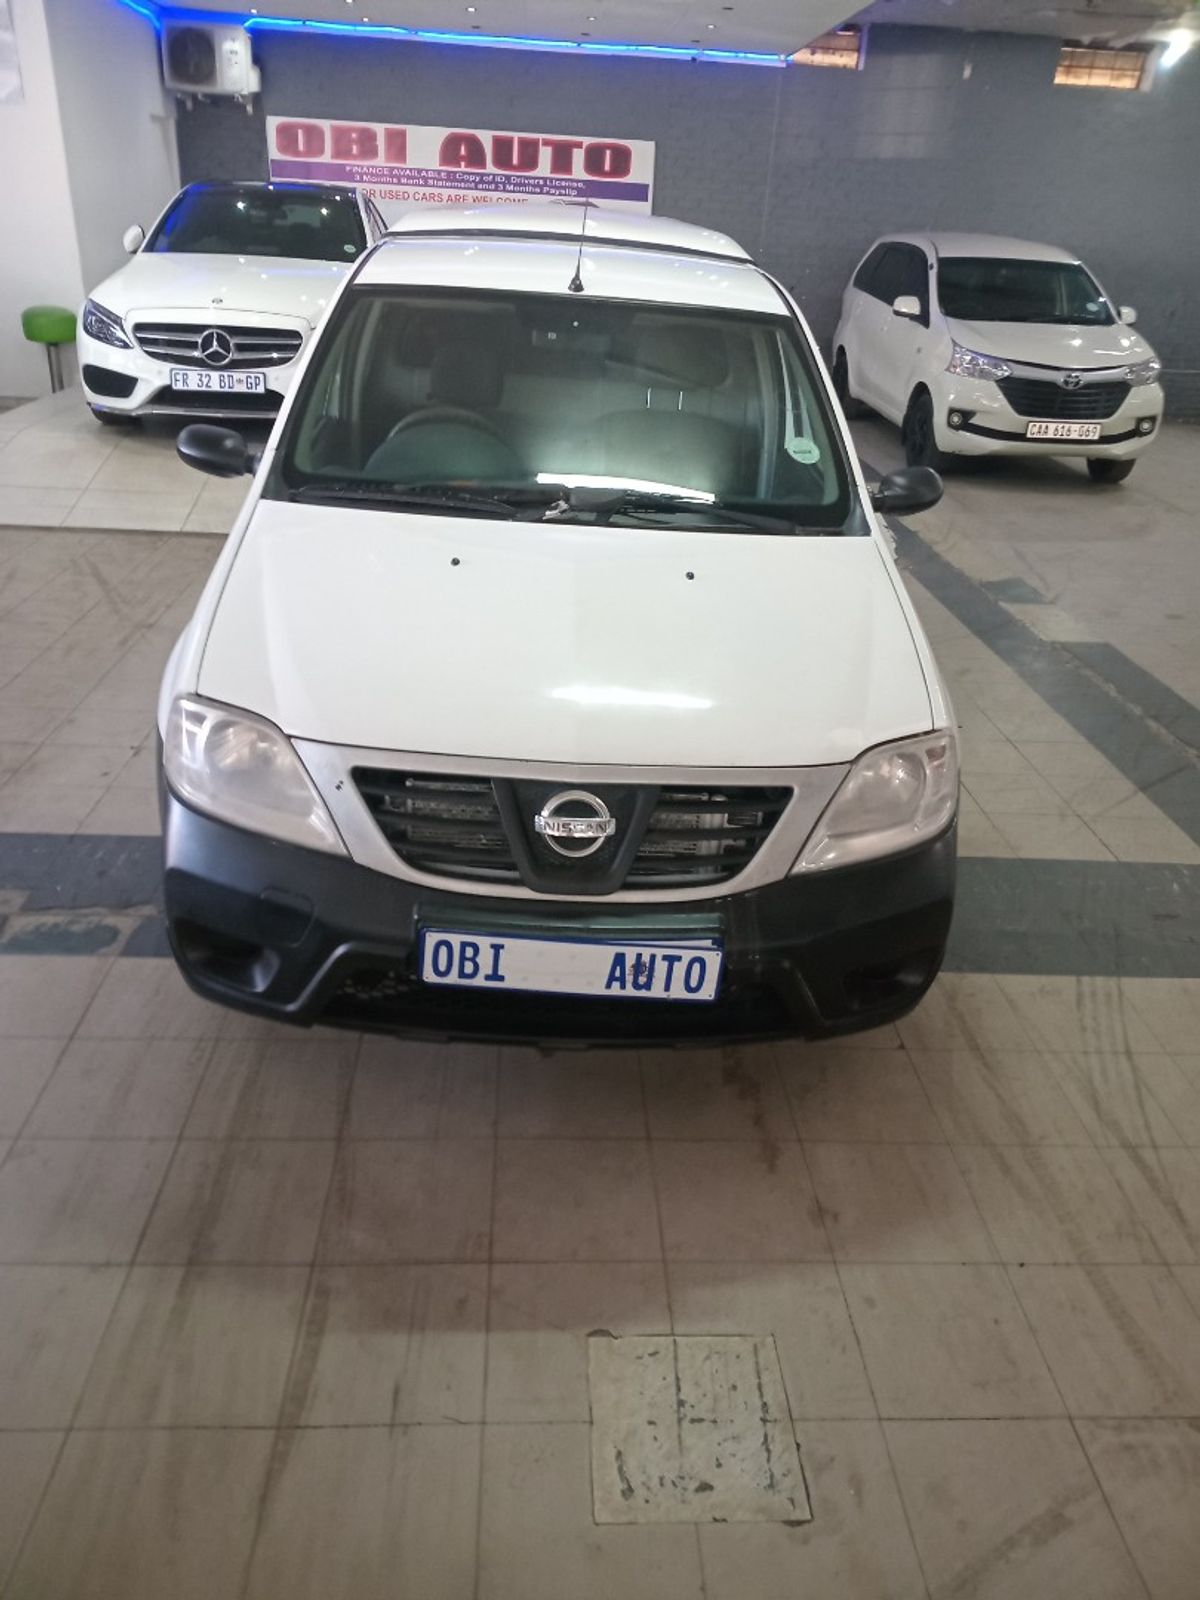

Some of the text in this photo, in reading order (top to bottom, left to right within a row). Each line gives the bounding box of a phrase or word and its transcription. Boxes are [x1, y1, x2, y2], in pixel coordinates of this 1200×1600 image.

[275, 120, 633, 180] OBI AUTO
[345, 166, 390, 175] FINANCE
[392, 168, 447, 179] AVAILABLE
[455, 172, 481, 184] Copy
[511, 176, 544, 186] Drivers
[363, 175, 399, 184] Months
[401, 178, 425, 186] Bank
[427, 179, 476, 189] Statement
[477, 181, 496, 190] and
[498, 183, 504, 191] 3
[506, 185, 541, 193] Months
[543, 187, 578, 197] Payslip
[379, 190, 410, 201] USED
[412, 191, 443, 203] CARS
[174, 372, 261, 391] FR 32 BD GP
[1029, 423, 1049, 437] CAA
[543, 820, 608, 834] NISSAN
[431, 939, 708, 995] OBI AUTO
